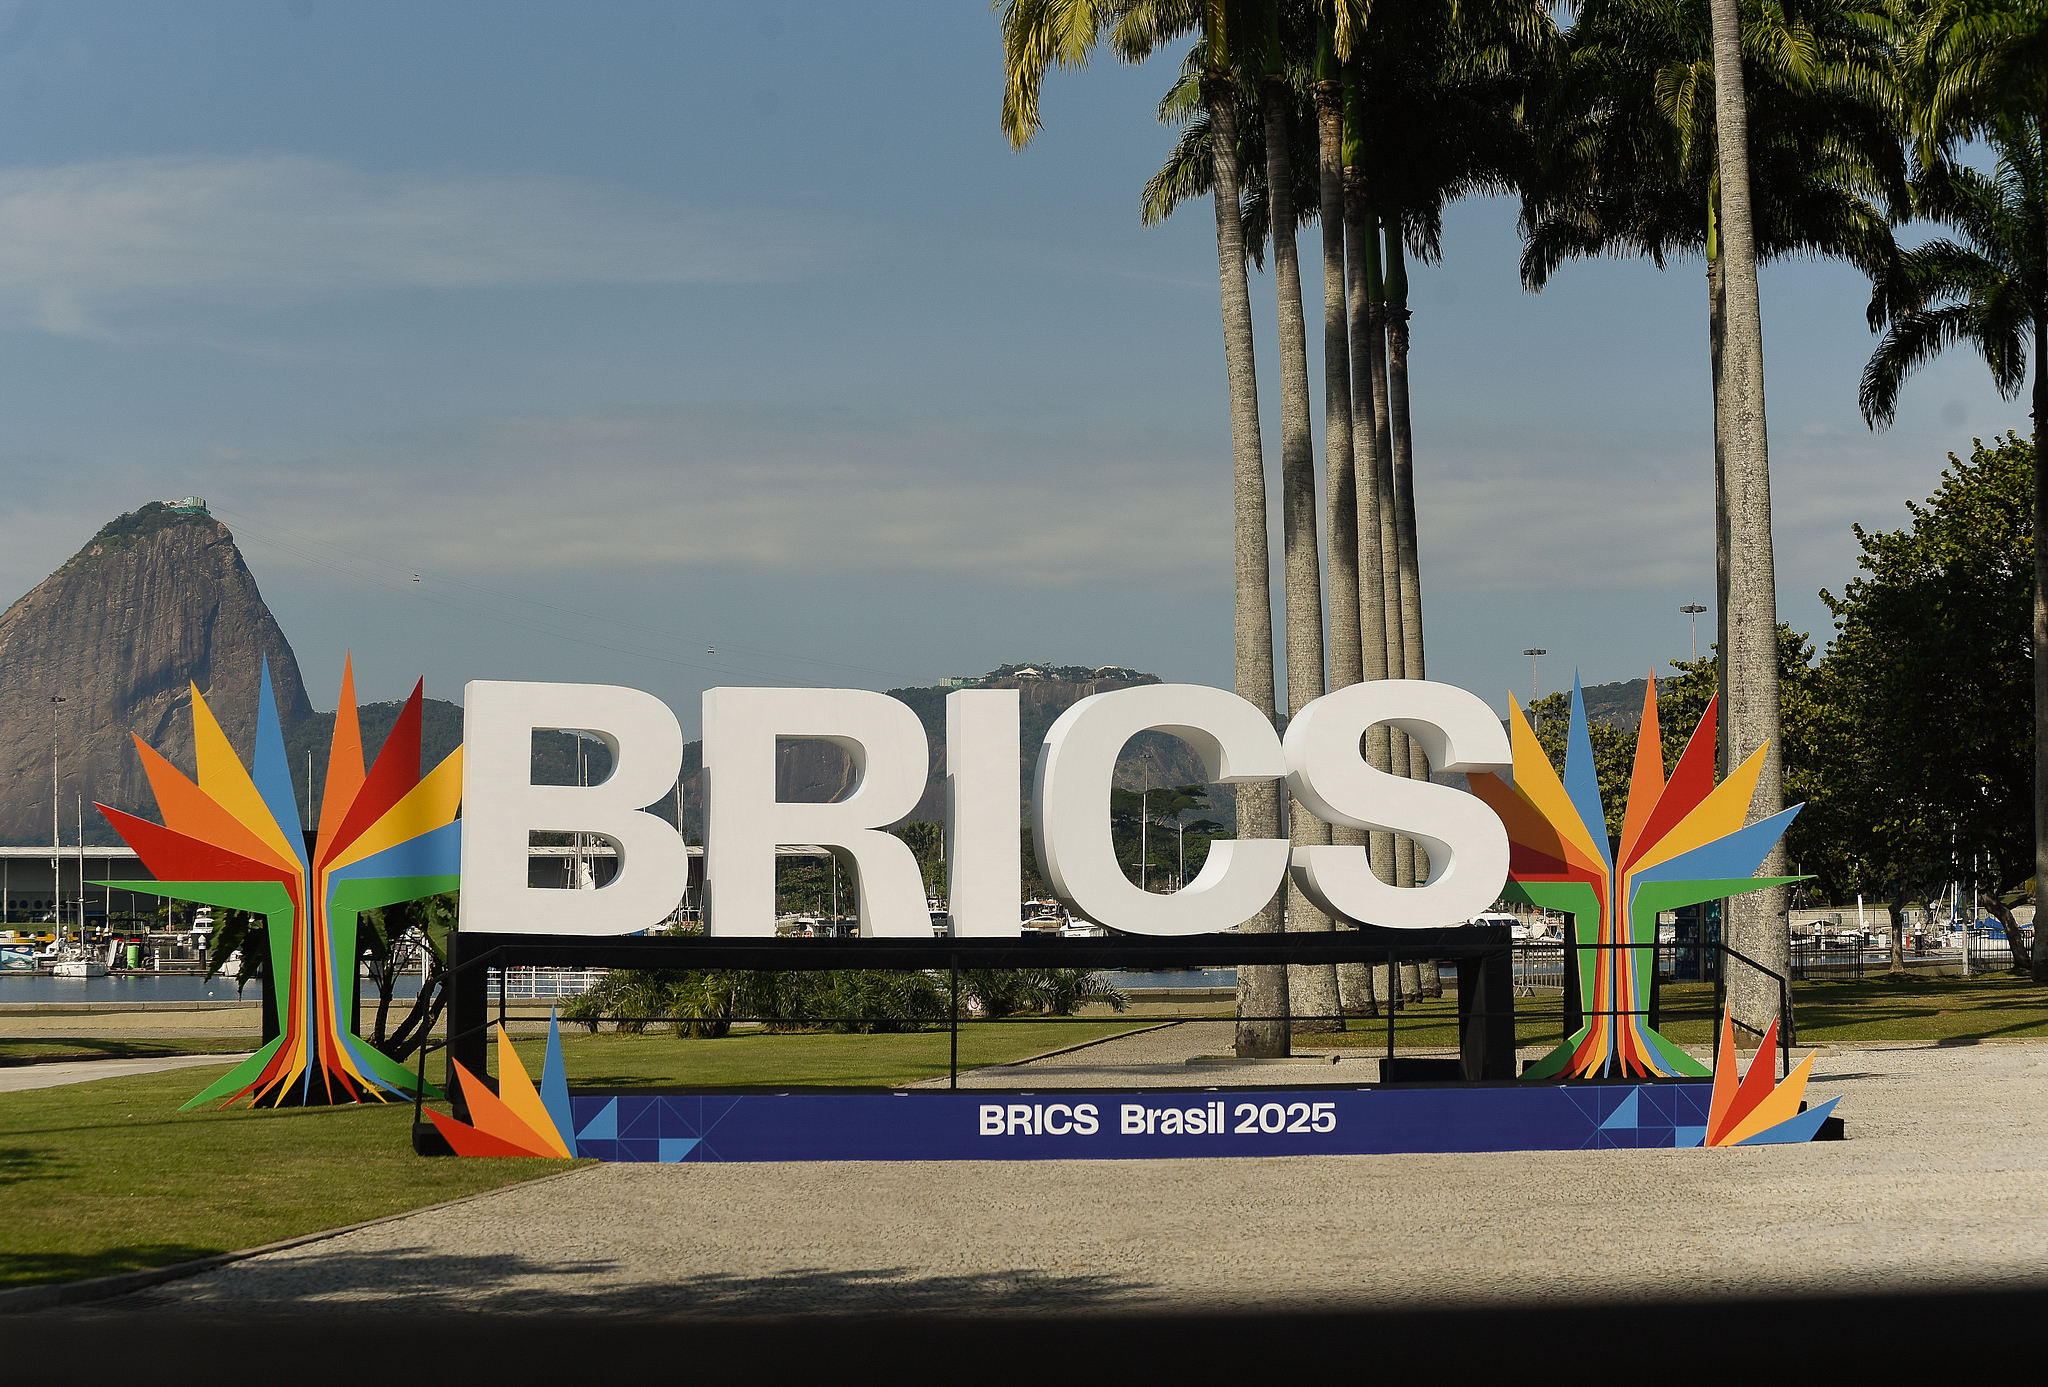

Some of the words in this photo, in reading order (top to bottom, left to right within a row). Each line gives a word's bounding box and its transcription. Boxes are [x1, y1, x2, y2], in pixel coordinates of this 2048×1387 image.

[460, 679, 1513, 938] BRICS
[979, 1103, 1100, 1136] BRICS
[1120, 1101, 1225, 1135] Brasil
[1234, 1102, 1337, 1134] 2025
